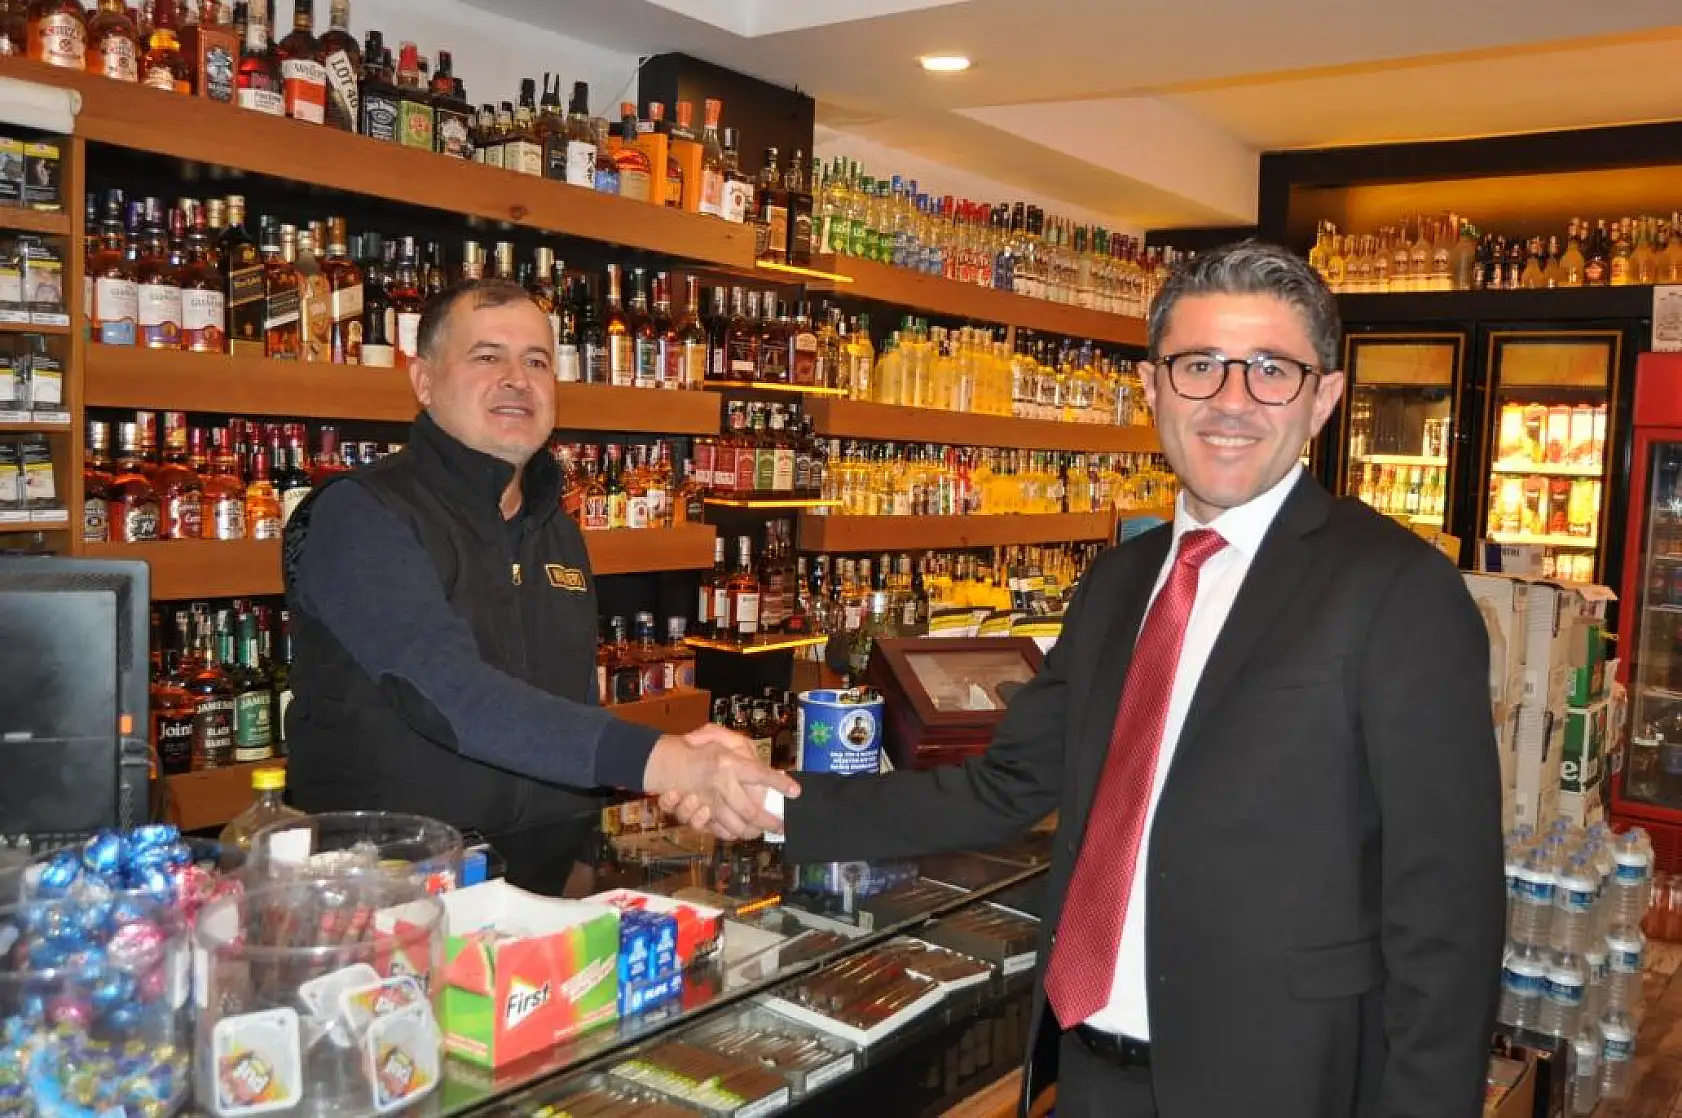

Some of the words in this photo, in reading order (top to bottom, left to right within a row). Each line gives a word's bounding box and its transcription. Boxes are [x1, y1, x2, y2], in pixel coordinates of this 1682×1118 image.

[331, 57, 353, 86] LOT
[160, 722, 193, 741] Joint
[505, 982, 551, 1018] First
